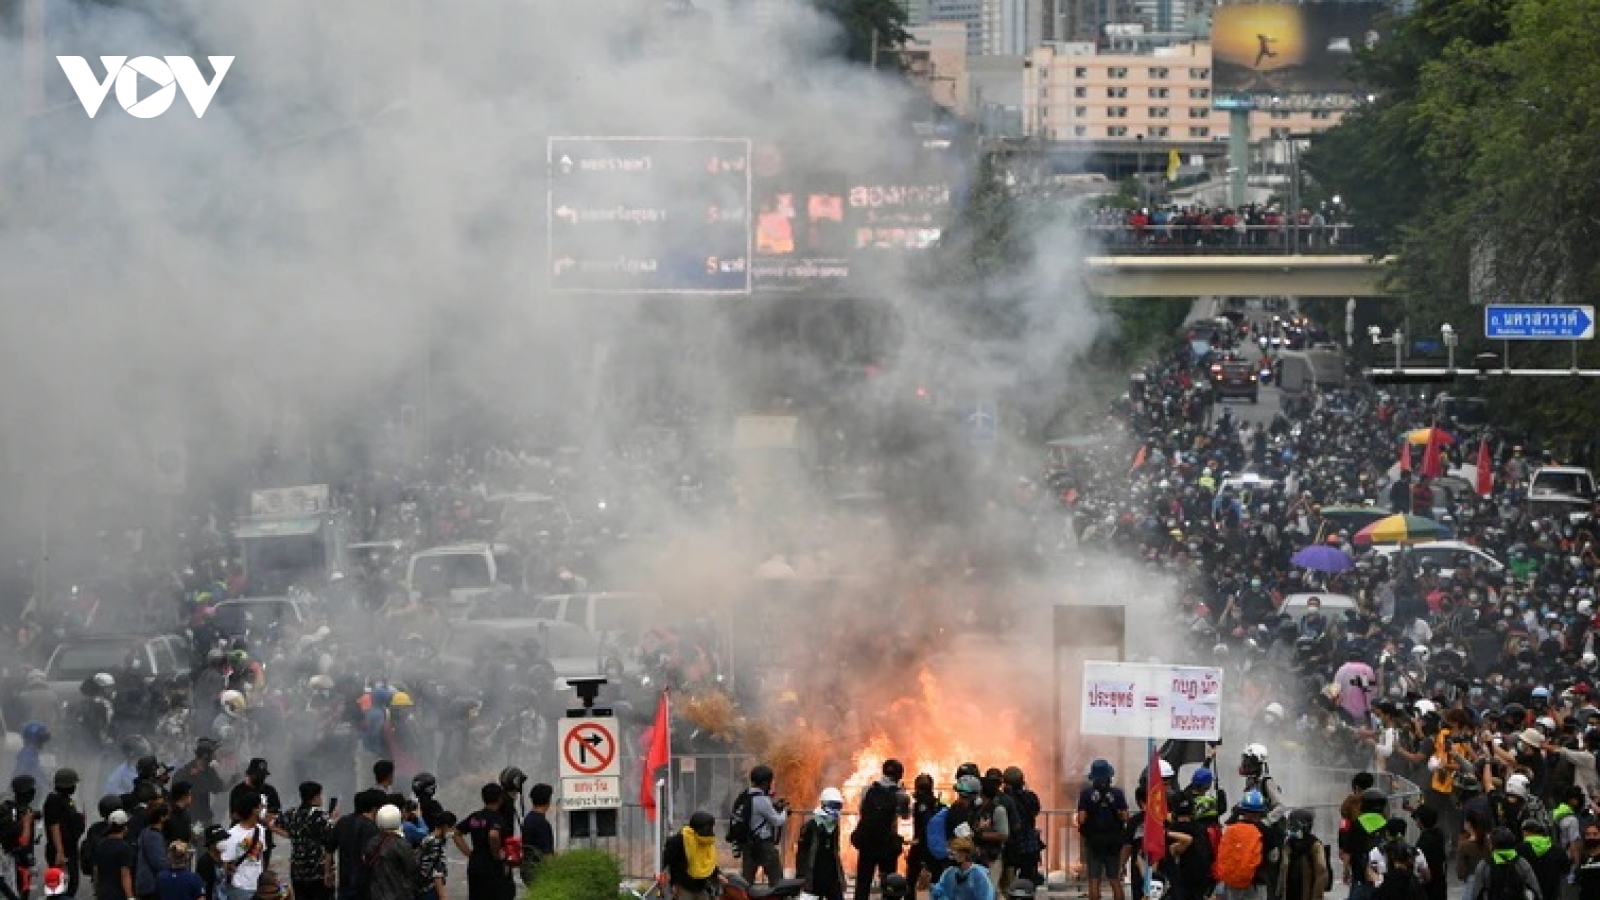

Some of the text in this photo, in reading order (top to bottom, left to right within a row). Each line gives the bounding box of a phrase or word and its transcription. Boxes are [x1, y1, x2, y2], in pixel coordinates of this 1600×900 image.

[1503, 310, 1578, 326] นครสวรรค์
[1087, 682, 1136, 716] ประยุทธ์
